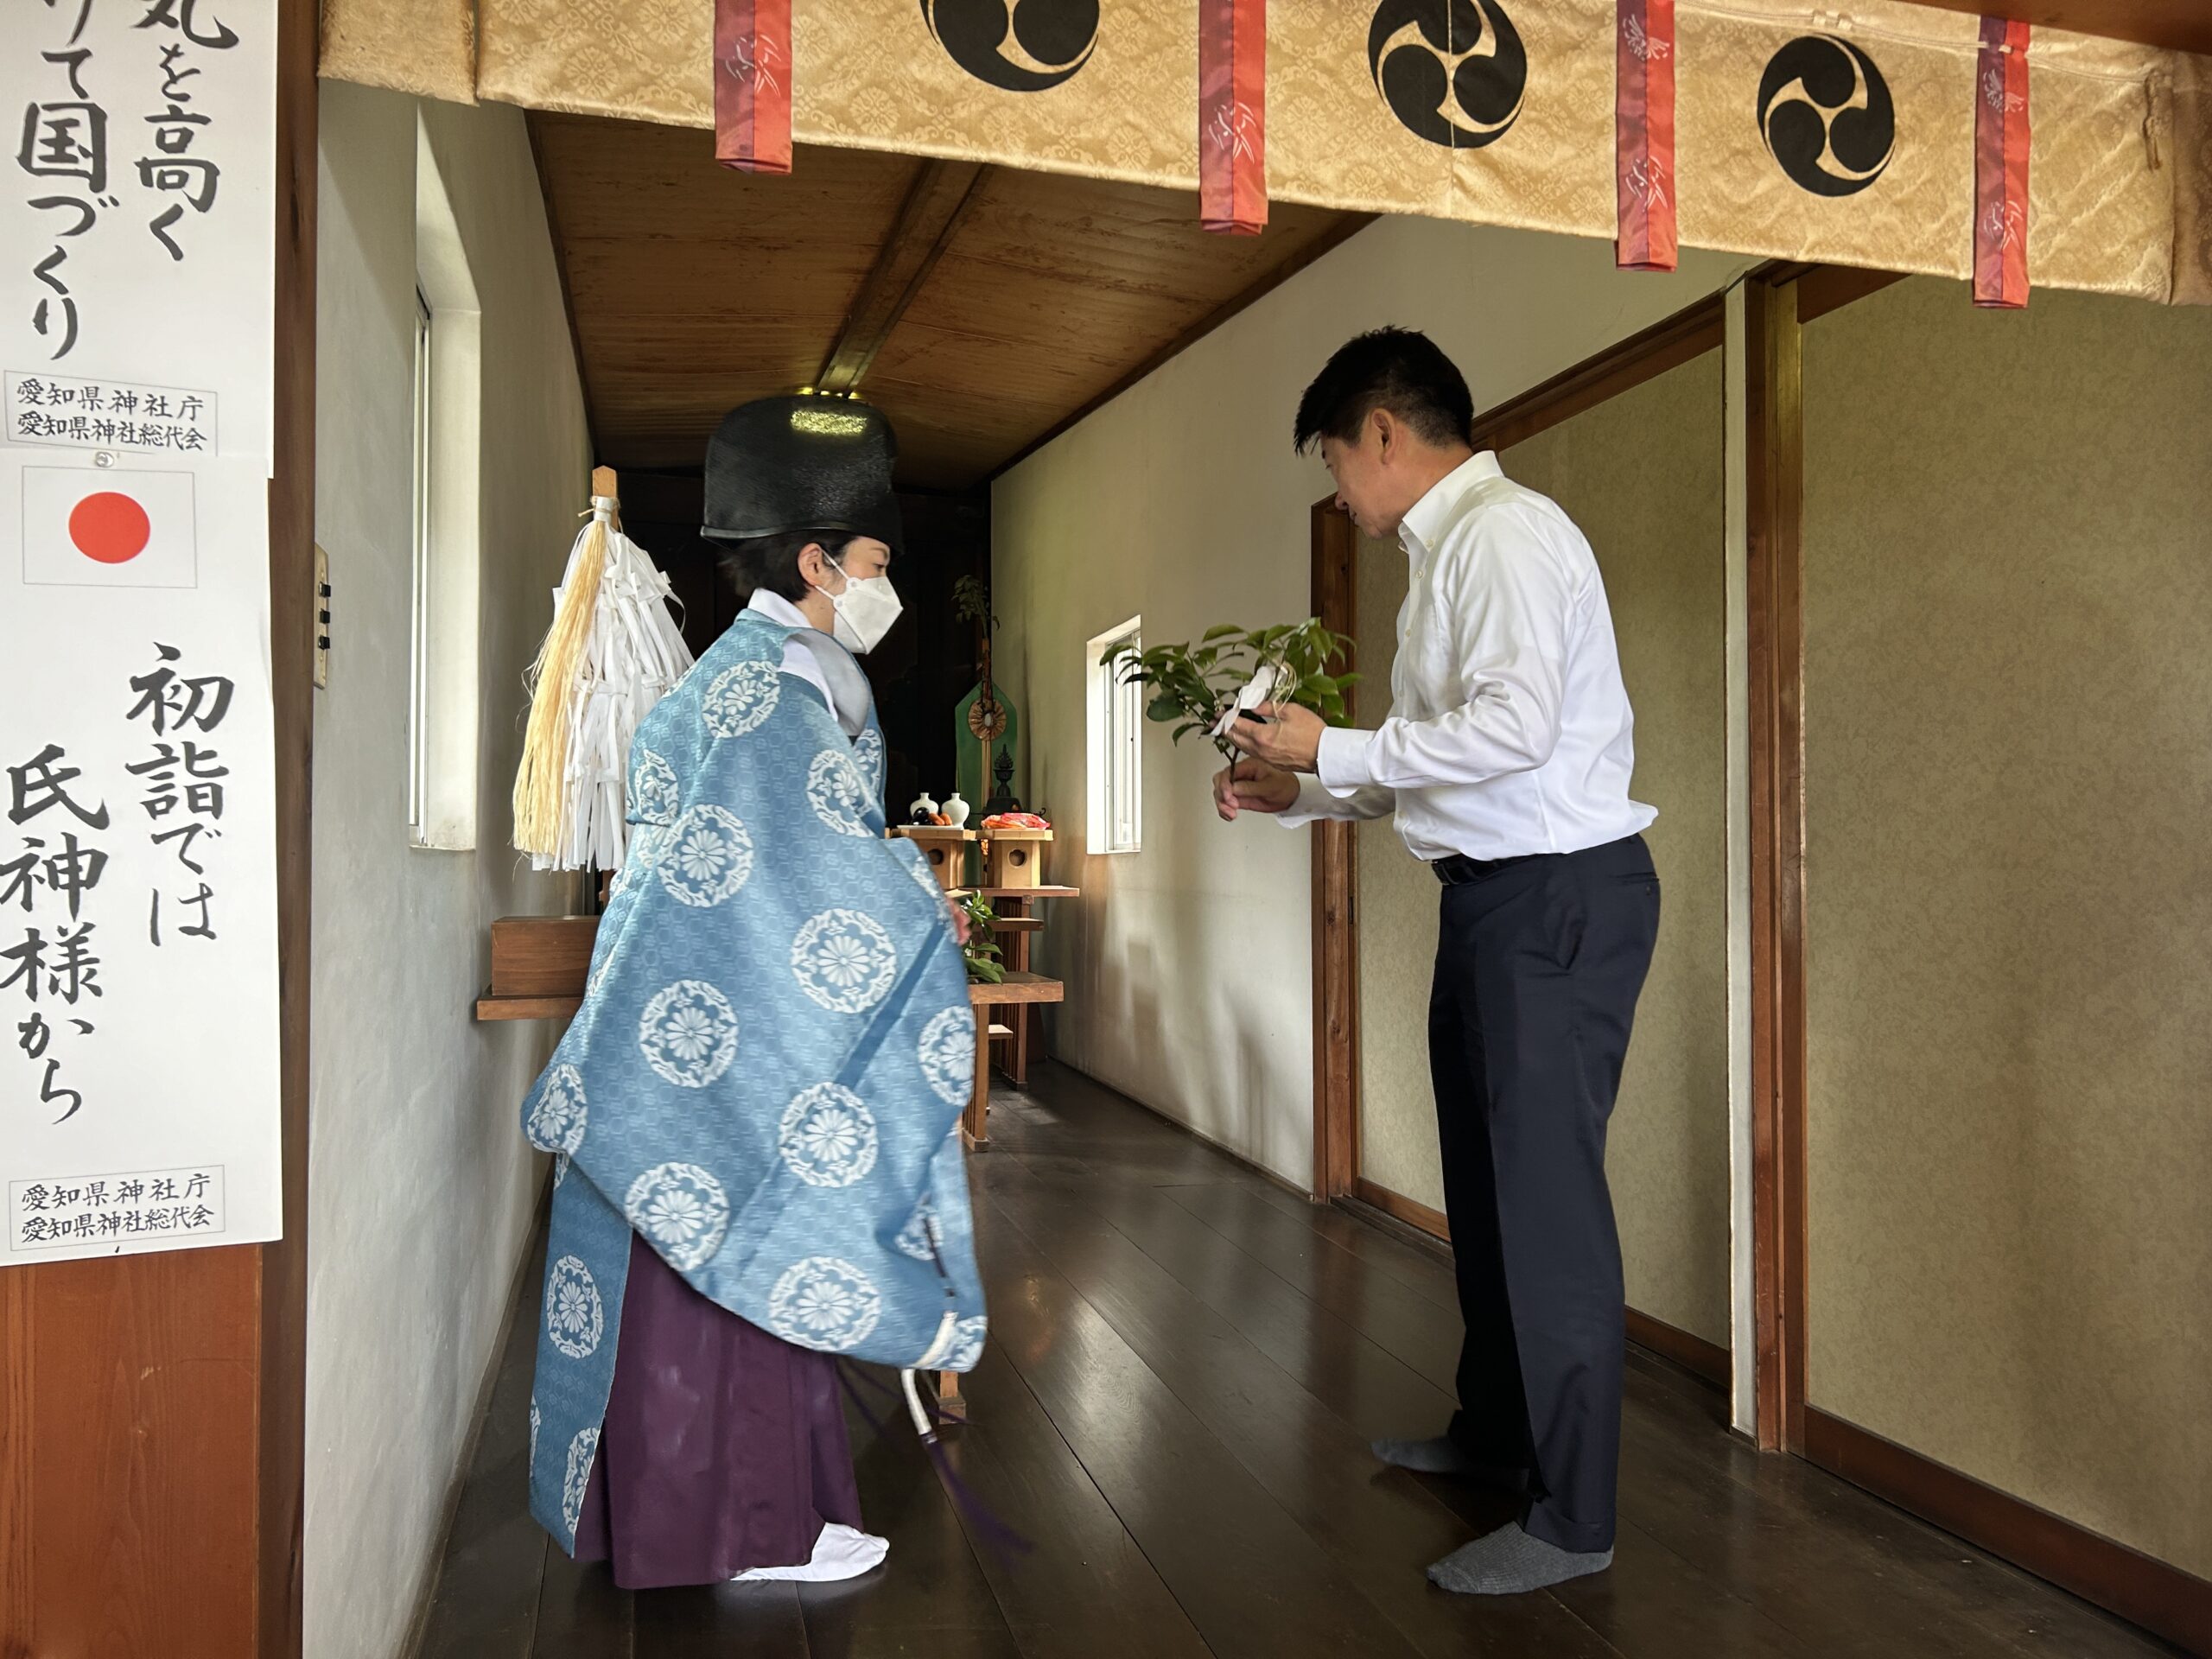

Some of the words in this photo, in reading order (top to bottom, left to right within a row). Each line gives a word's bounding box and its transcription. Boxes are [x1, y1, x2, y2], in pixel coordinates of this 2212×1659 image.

[16, 378, 204, 422] 愛知県神社庁
[17, 410, 207, 451] 愛知県神社総代会
[125, 642, 234, 947] 初詣では
[0, 744, 110, 1125] 氏神様から
[22, 1173, 211, 1211] 愛知県神社庁
[22, 1204, 214, 1243] 愛知県神社総代会
